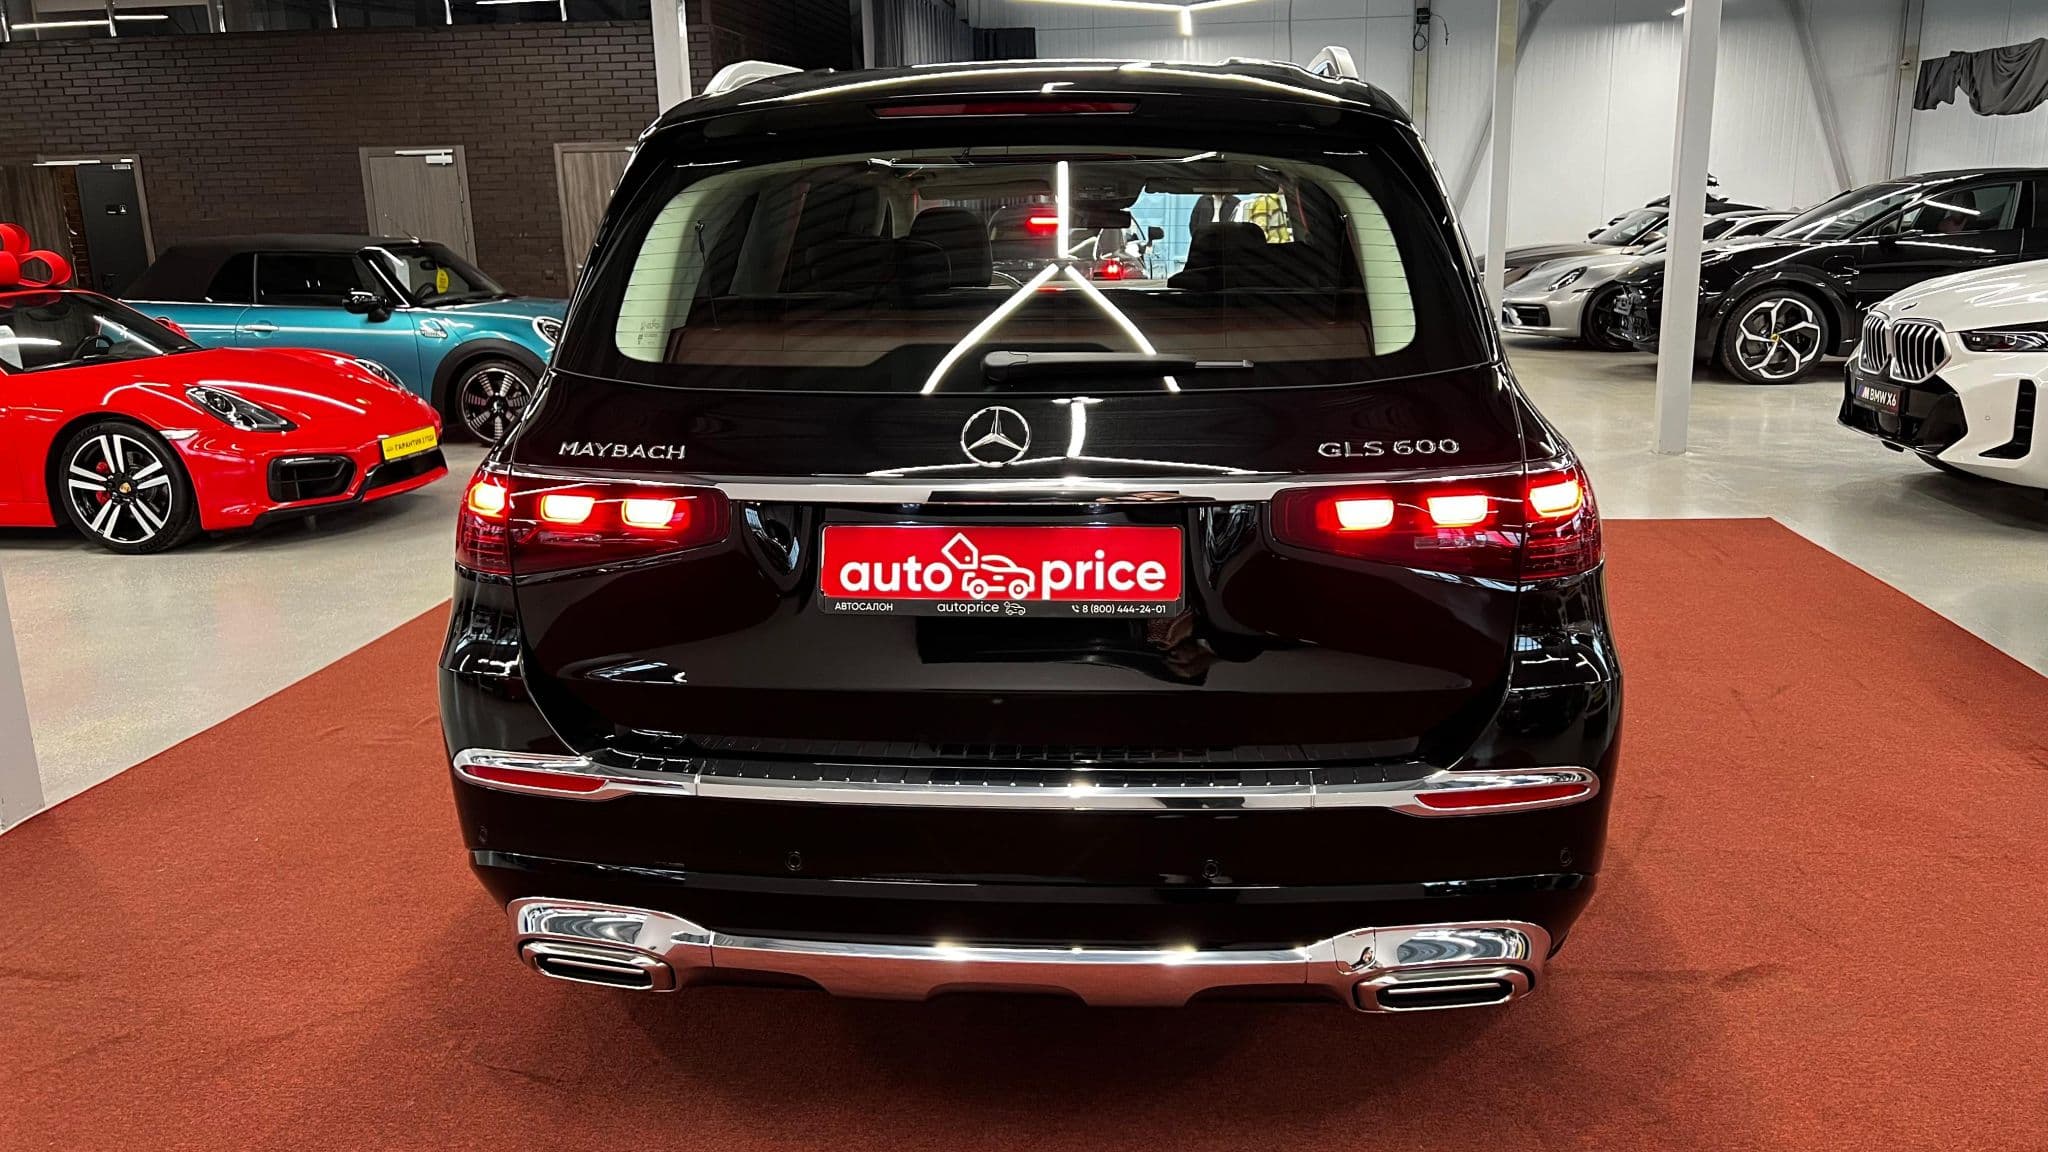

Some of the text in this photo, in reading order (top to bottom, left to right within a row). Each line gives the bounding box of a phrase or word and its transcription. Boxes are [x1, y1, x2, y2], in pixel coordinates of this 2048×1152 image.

[1870, 387, 1887, 405] BMW
[1887, 391, 1897, 407] X6
[558, 441, 686, 460] MAYBACH
[1317, 438, 1460, 458] GLS 600
[839, 549, 1167, 600] auto price
[834, 602, 894, 612] АВТОСАЛОН
[936, 601, 1000, 615] autoprice
[1082, 604, 1166, 615] 8 (800) 444-24-01
